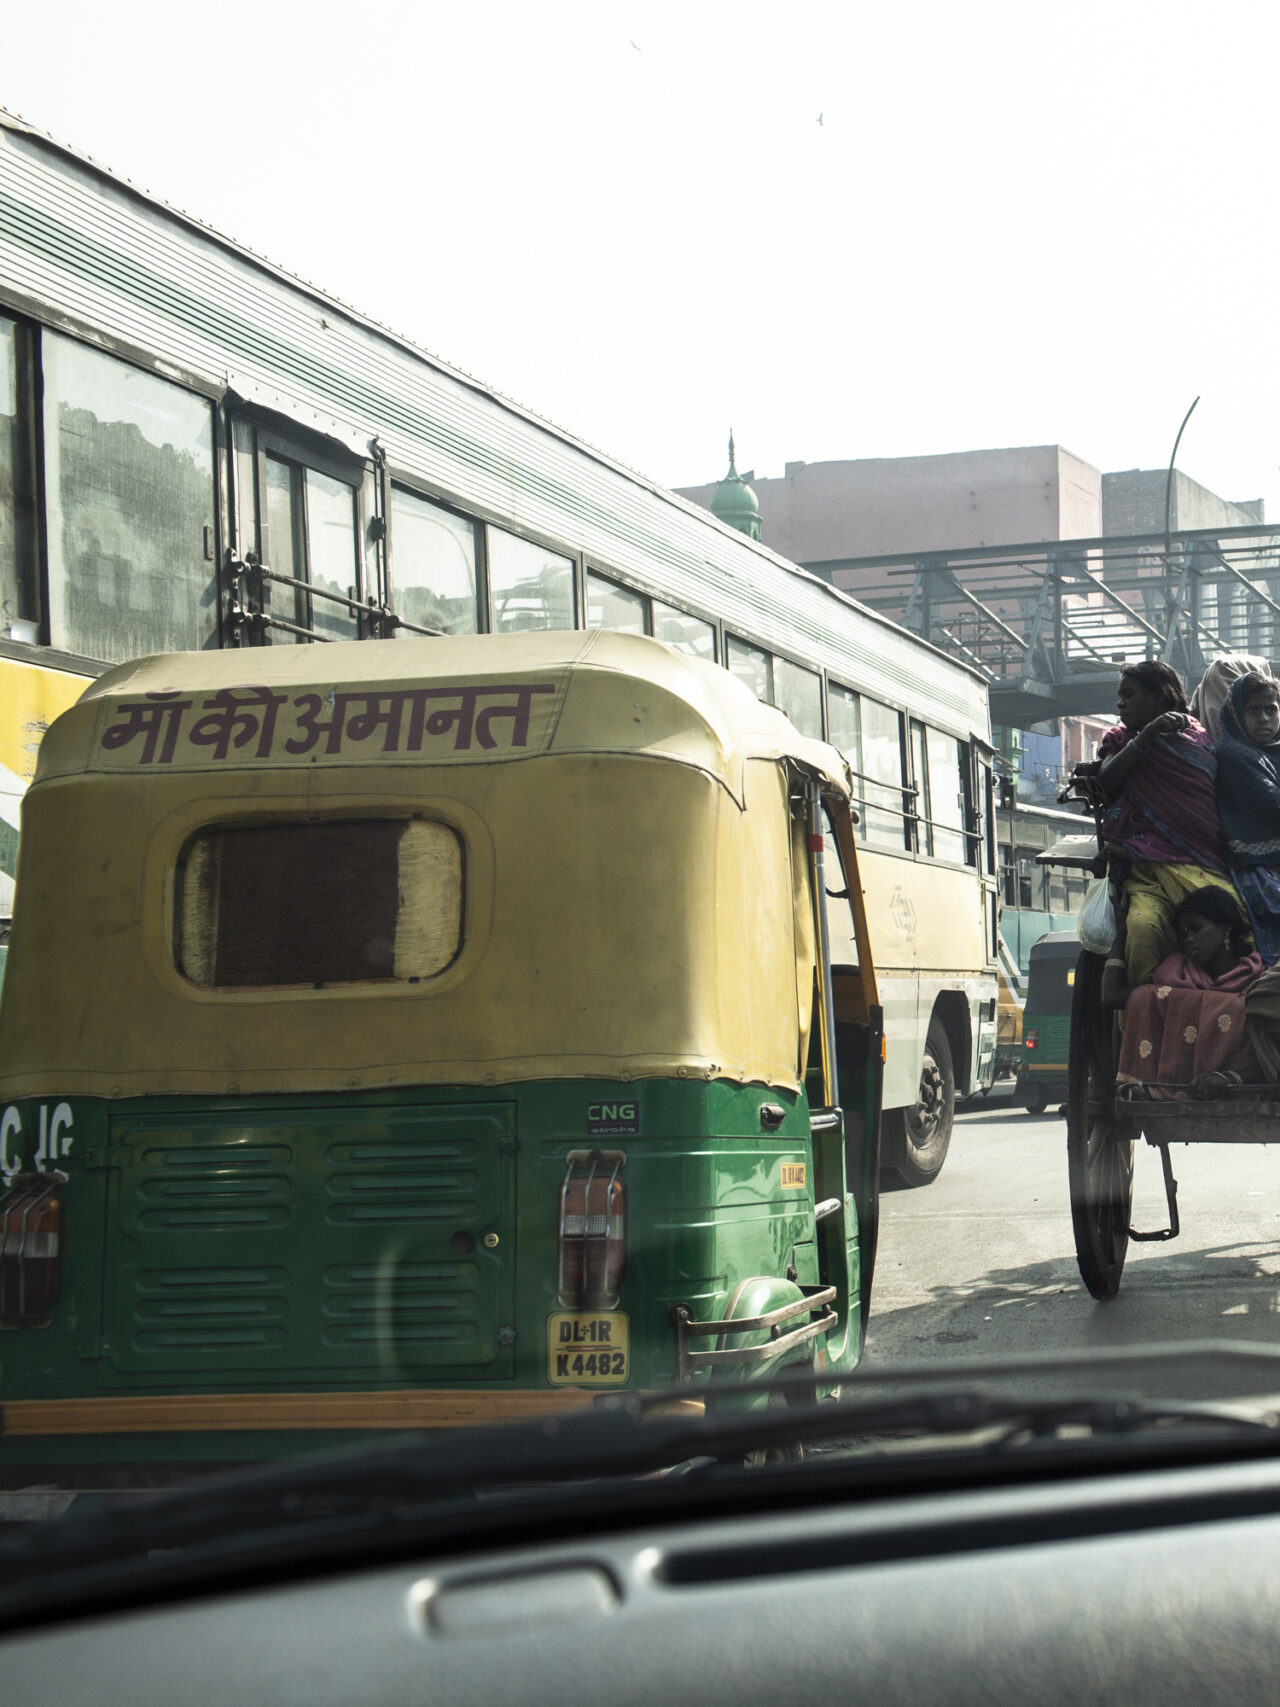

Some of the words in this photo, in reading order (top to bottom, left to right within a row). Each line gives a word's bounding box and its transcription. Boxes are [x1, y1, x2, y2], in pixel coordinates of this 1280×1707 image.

[189, 684, 288, 761] की
[285, 684, 556, 755] अमानत
[588, 1104, 635, 1120] CNG
